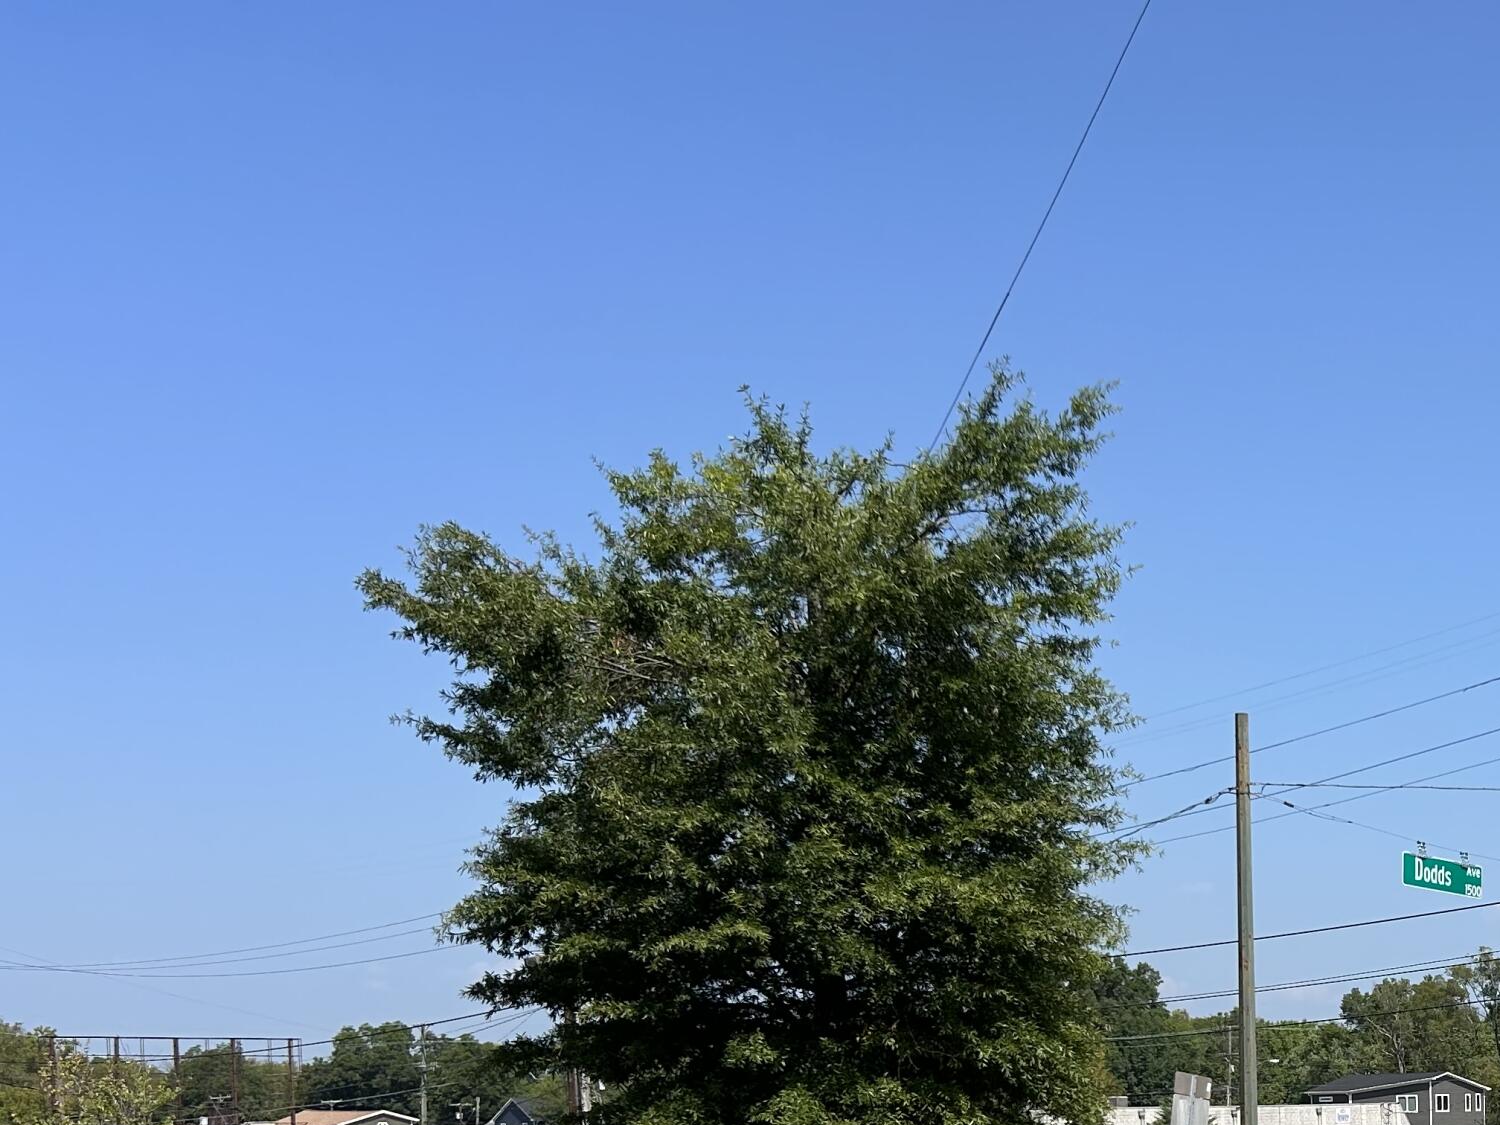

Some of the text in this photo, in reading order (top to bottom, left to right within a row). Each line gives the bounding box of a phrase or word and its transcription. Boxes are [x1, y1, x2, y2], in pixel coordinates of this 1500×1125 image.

[1415, 857, 1451, 886] Dodds
[1466, 867, 1480, 878] Ave
[1465, 884, 1481, 896] 1500
